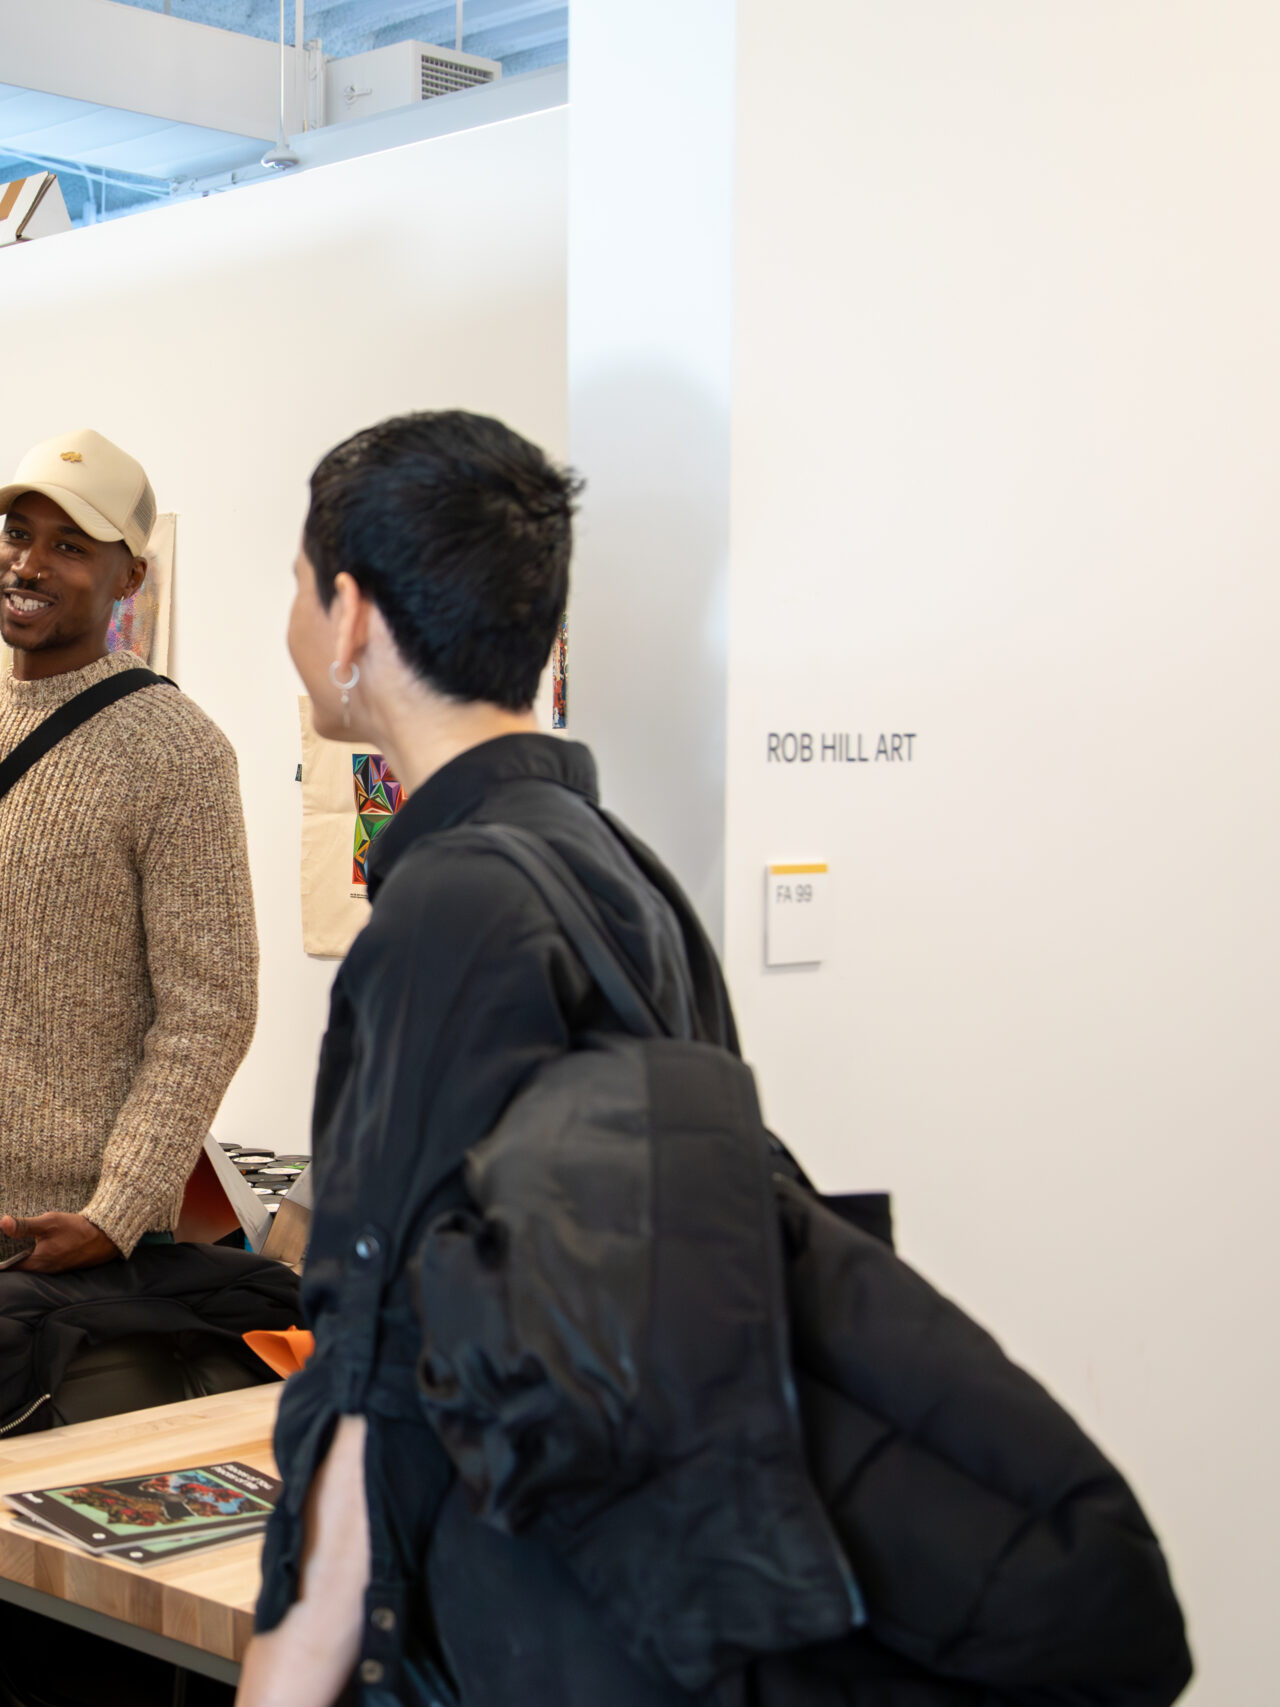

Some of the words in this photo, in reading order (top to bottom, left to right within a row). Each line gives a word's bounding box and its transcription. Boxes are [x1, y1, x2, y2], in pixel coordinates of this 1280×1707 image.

[767, 732, 813, 762] ROB
[821, 733, 869, 762] HILL
[874, 733, 917, 762] ART
[776, 884, 792, 903] FA
